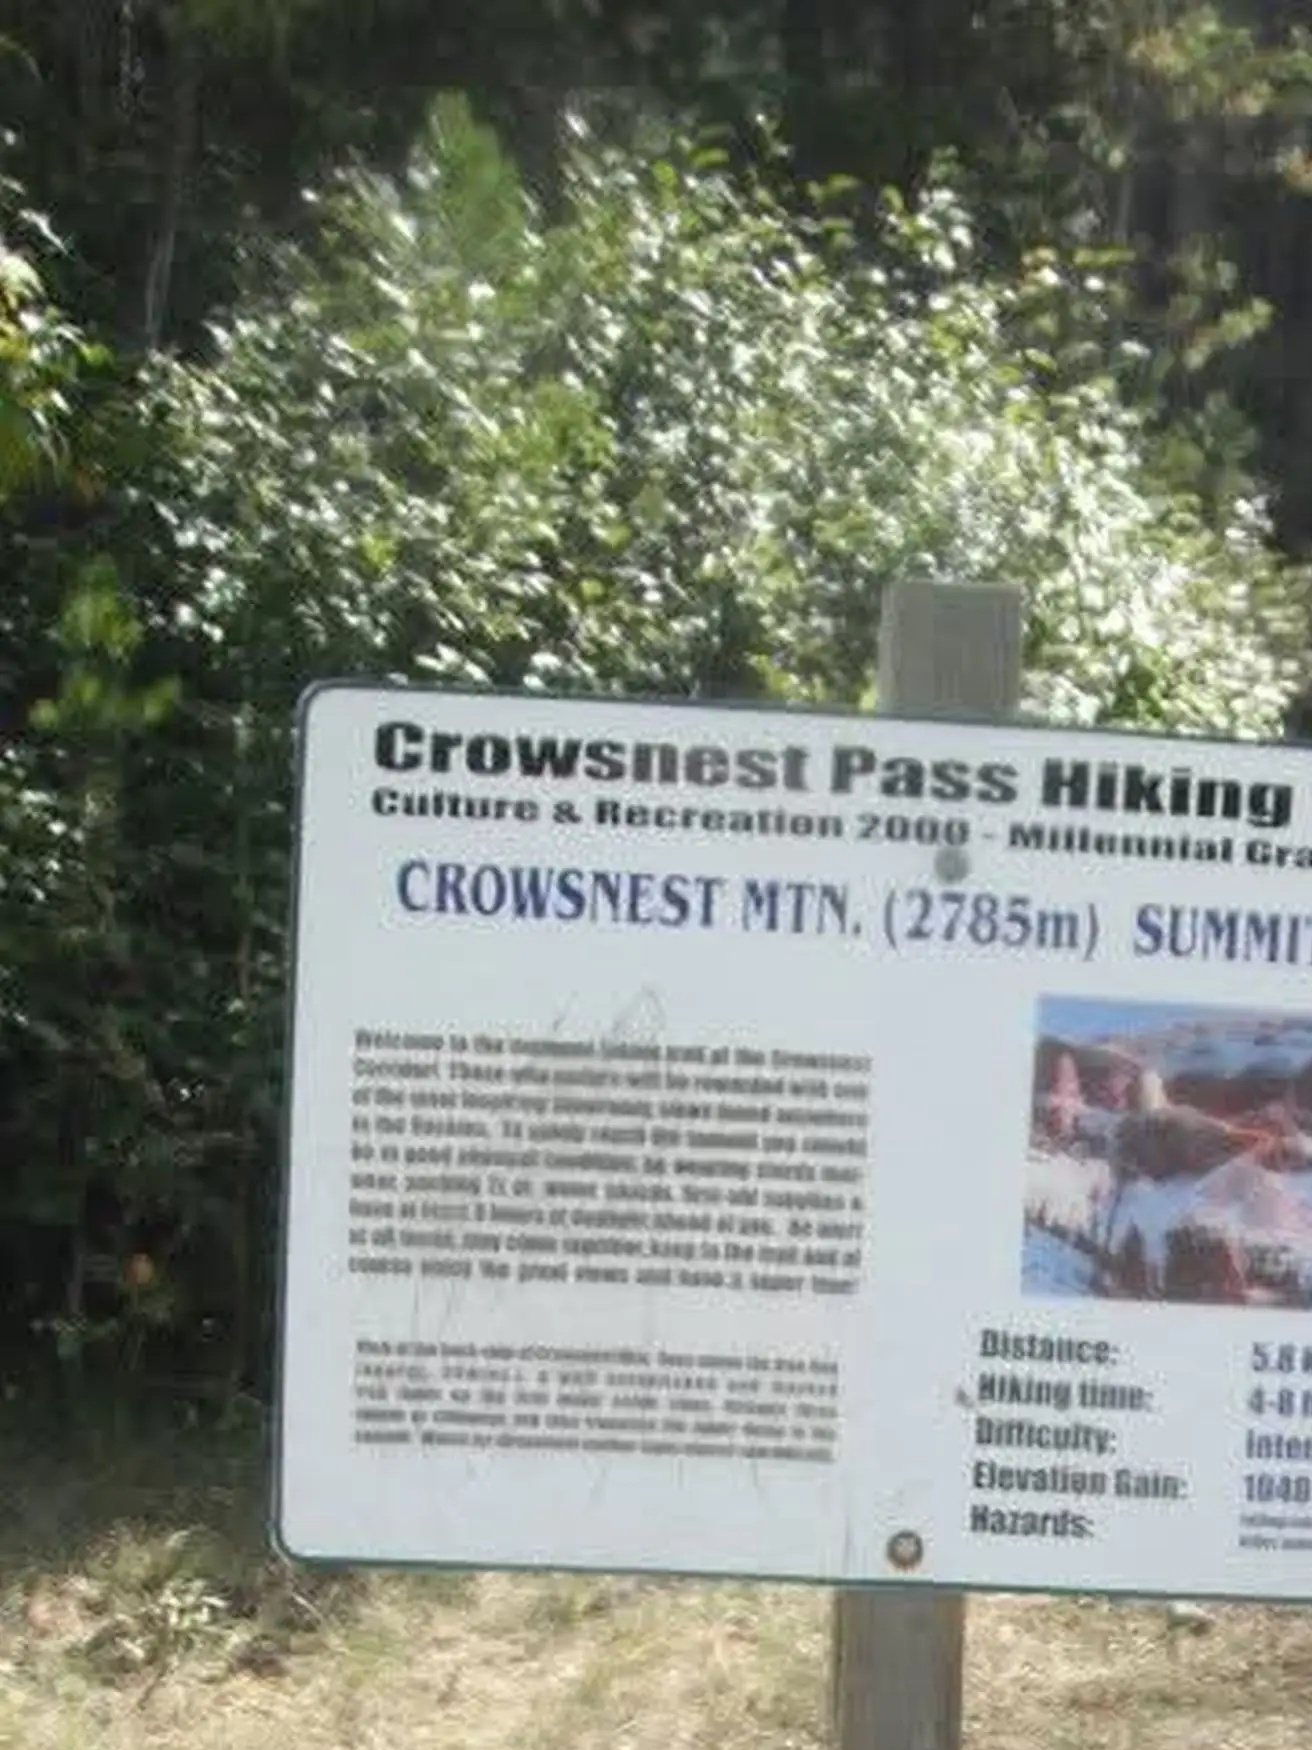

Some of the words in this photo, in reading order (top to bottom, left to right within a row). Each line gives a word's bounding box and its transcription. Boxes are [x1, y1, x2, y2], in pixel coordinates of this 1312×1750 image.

[373, 722, 808, 791] Crowsnest
[831, 746, 1017, 804] Pass
[1041, 759, 1292, 828] Hiking
[372, 788, 539, 821] Culture
[552, 801, 582, 824] &
[594, 798, 843, 838] Recreation
[859, 814, 968, 846] 2000
[1009, 820, 1237, 863] Millennial
[397, 860, 723, 927] CROWSNEST
[742, 880, 861, 935] MTN.
[884, 889, 1099, 952] (2785m)
[980, 1329, 1118, 1365] Distance:
[1252, 1342, 1296, 1374] 5.8
[978, 1373, 1071, 1411] Hiking
[1078, 1379, 1153, 1411] time:
[1248, 1387, 1295, 1418] 4-8
[975, 1416, 1116, 1456] Difficulty:
[973, 1460, 1107, 1496] Elevation
[1114, 1468, 1187, 1500] Gain:
[970, 1505, 1094, 1538] Hazards:
